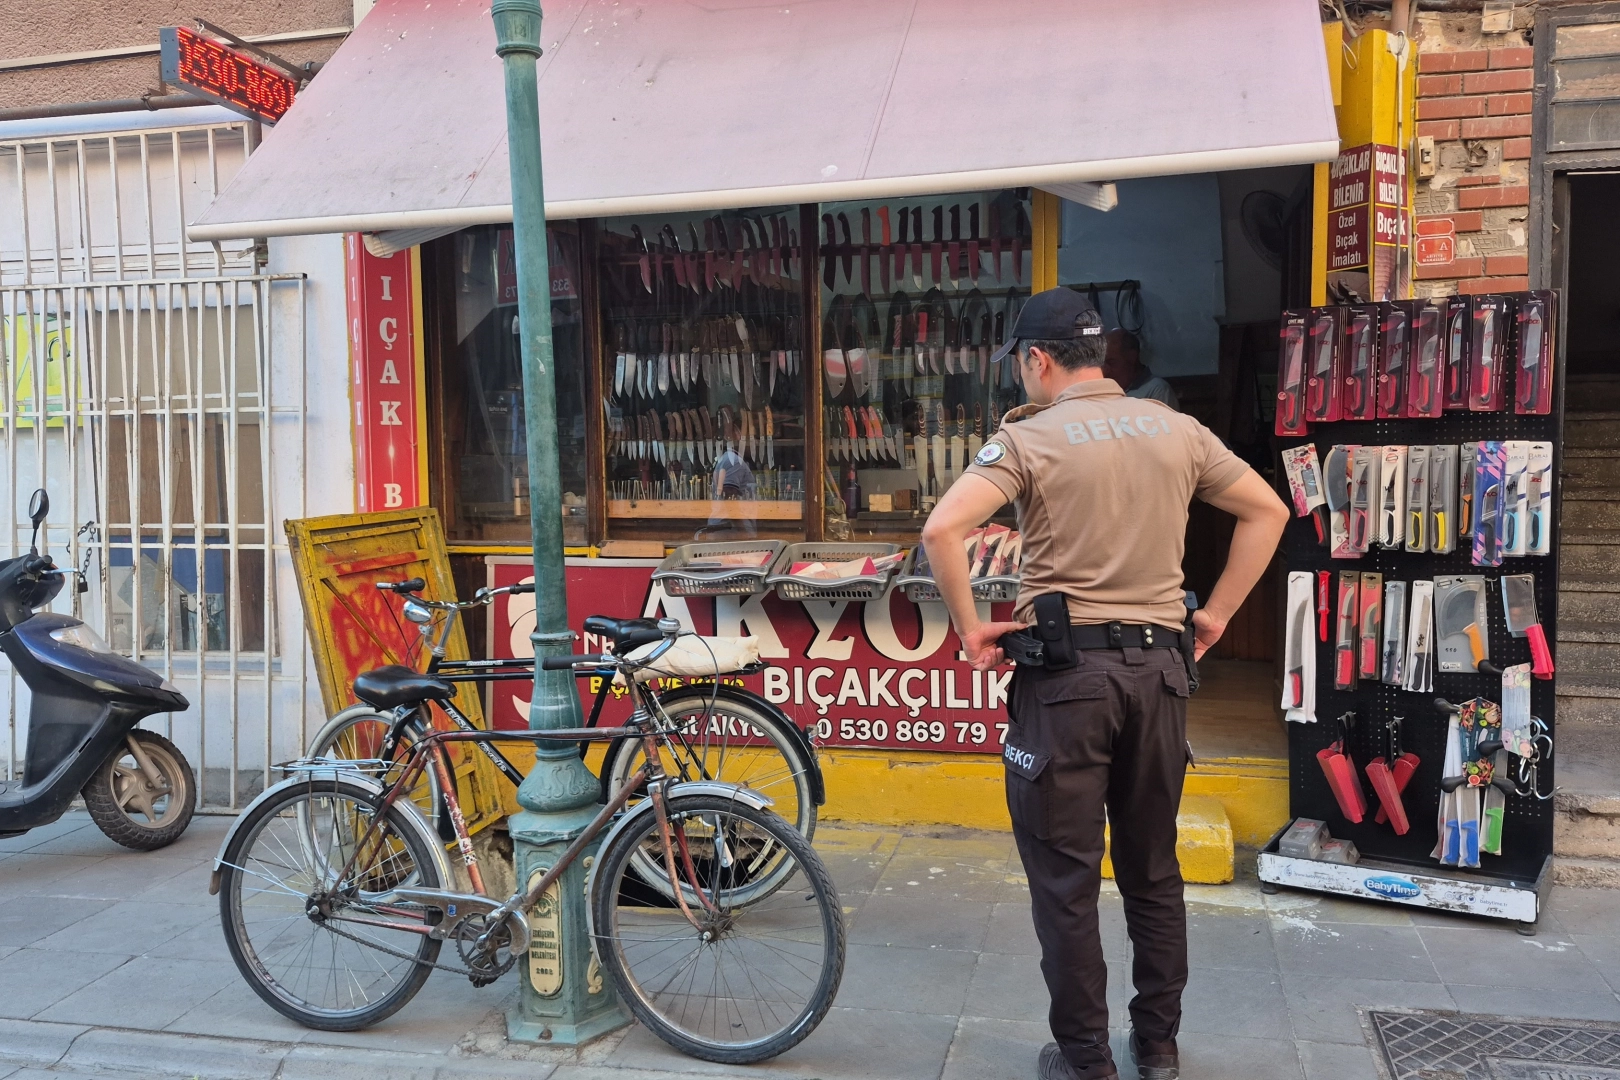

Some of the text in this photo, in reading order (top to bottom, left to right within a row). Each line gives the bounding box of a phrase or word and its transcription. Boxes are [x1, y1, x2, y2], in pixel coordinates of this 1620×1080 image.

[1375, 150, 1406, 175] BIÇAKLR
[1333, 178, 1364, 208] BİLENİR
[1338, 211, 1356, 229] Özel
[1335, 231, 1359, 250] Bıçak
[1420, 241, 1449, 252] 1 A
[1332, 251, 1361, 268] İmalatı
[378, 251, 403, 426] IÇAK
[763, 667, 1014, 717] BIÇAKÇILIK
[840, 719, 888, 740] 530
[895, 720, 946, 744] 869
[953, 722, 987, 744] 79
[995, 723, 1010, 745] 7
[1366, 879, 1417, 896] BabyTime
